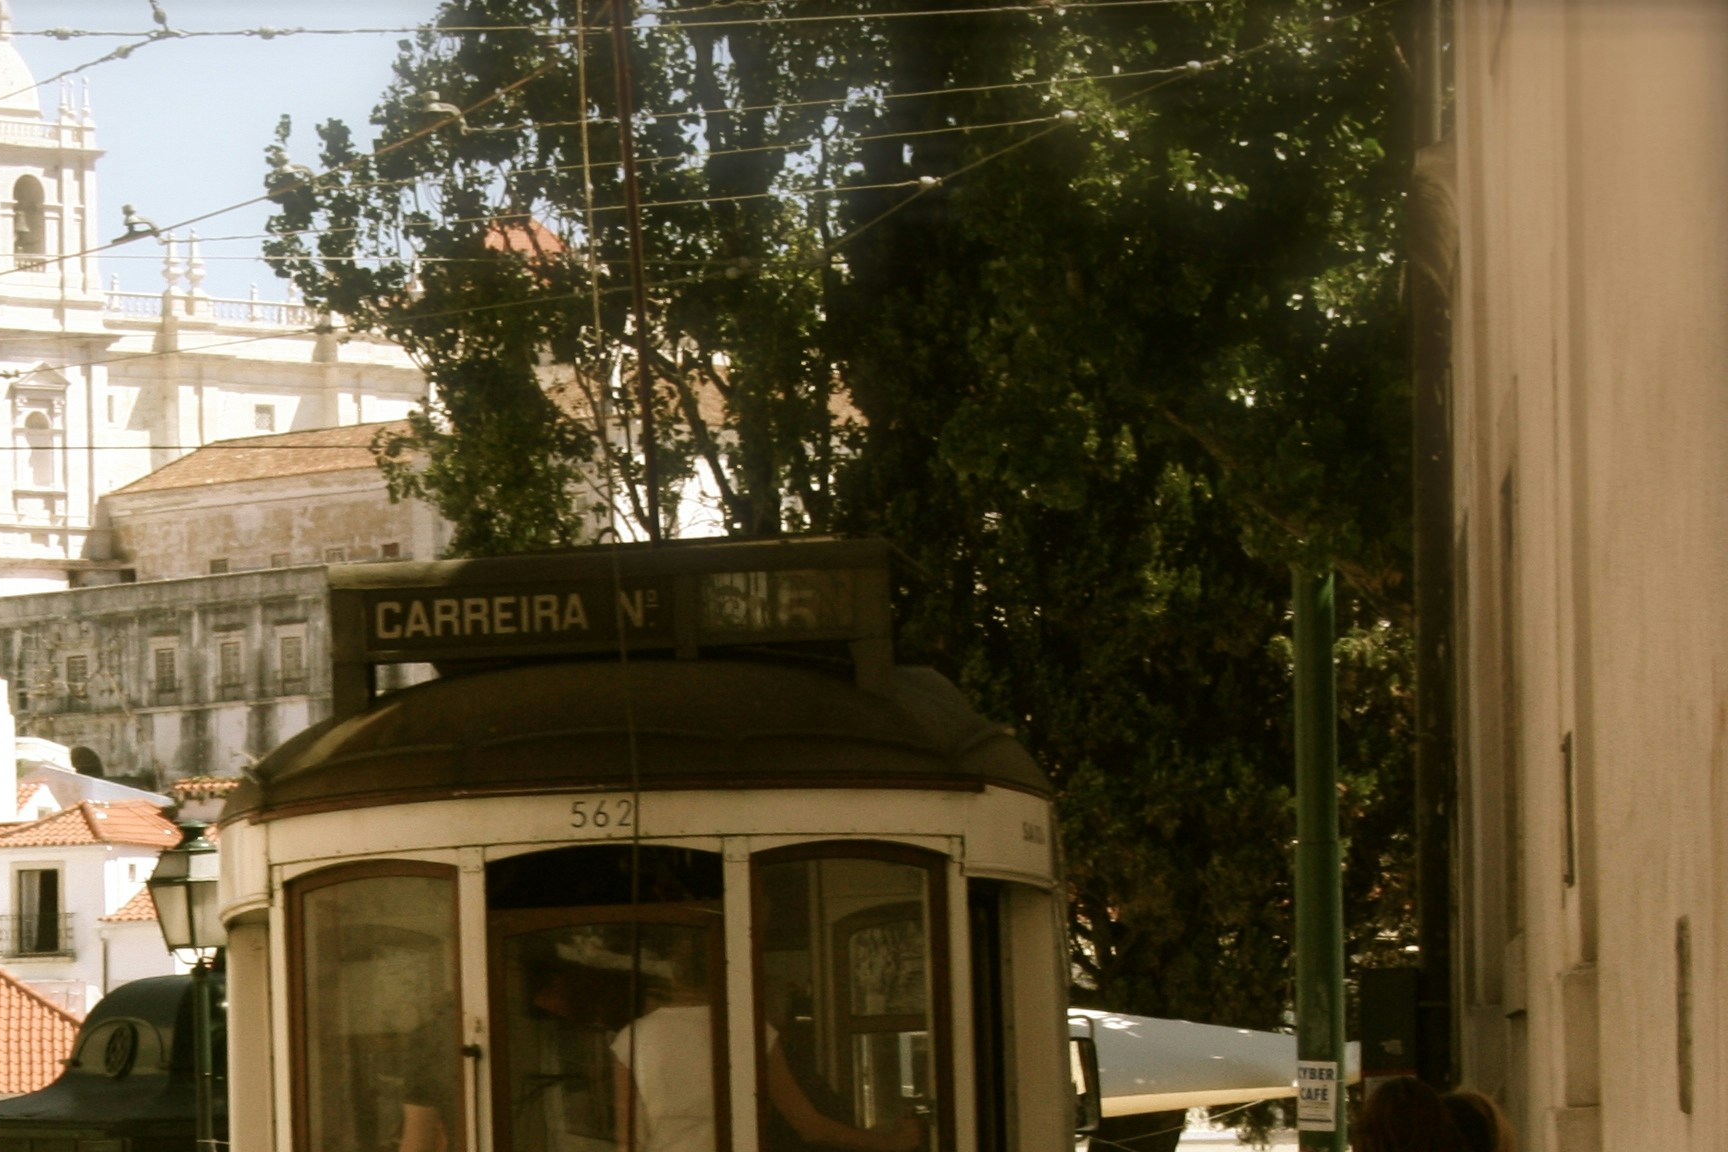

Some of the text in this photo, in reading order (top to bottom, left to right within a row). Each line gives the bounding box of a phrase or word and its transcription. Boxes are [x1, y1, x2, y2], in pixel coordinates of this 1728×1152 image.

[375, 593, 589, 639] CARREIRA
[571, 799, 632, 828] 562
[1300, 1084, 1329, 1101] CAFÉ
